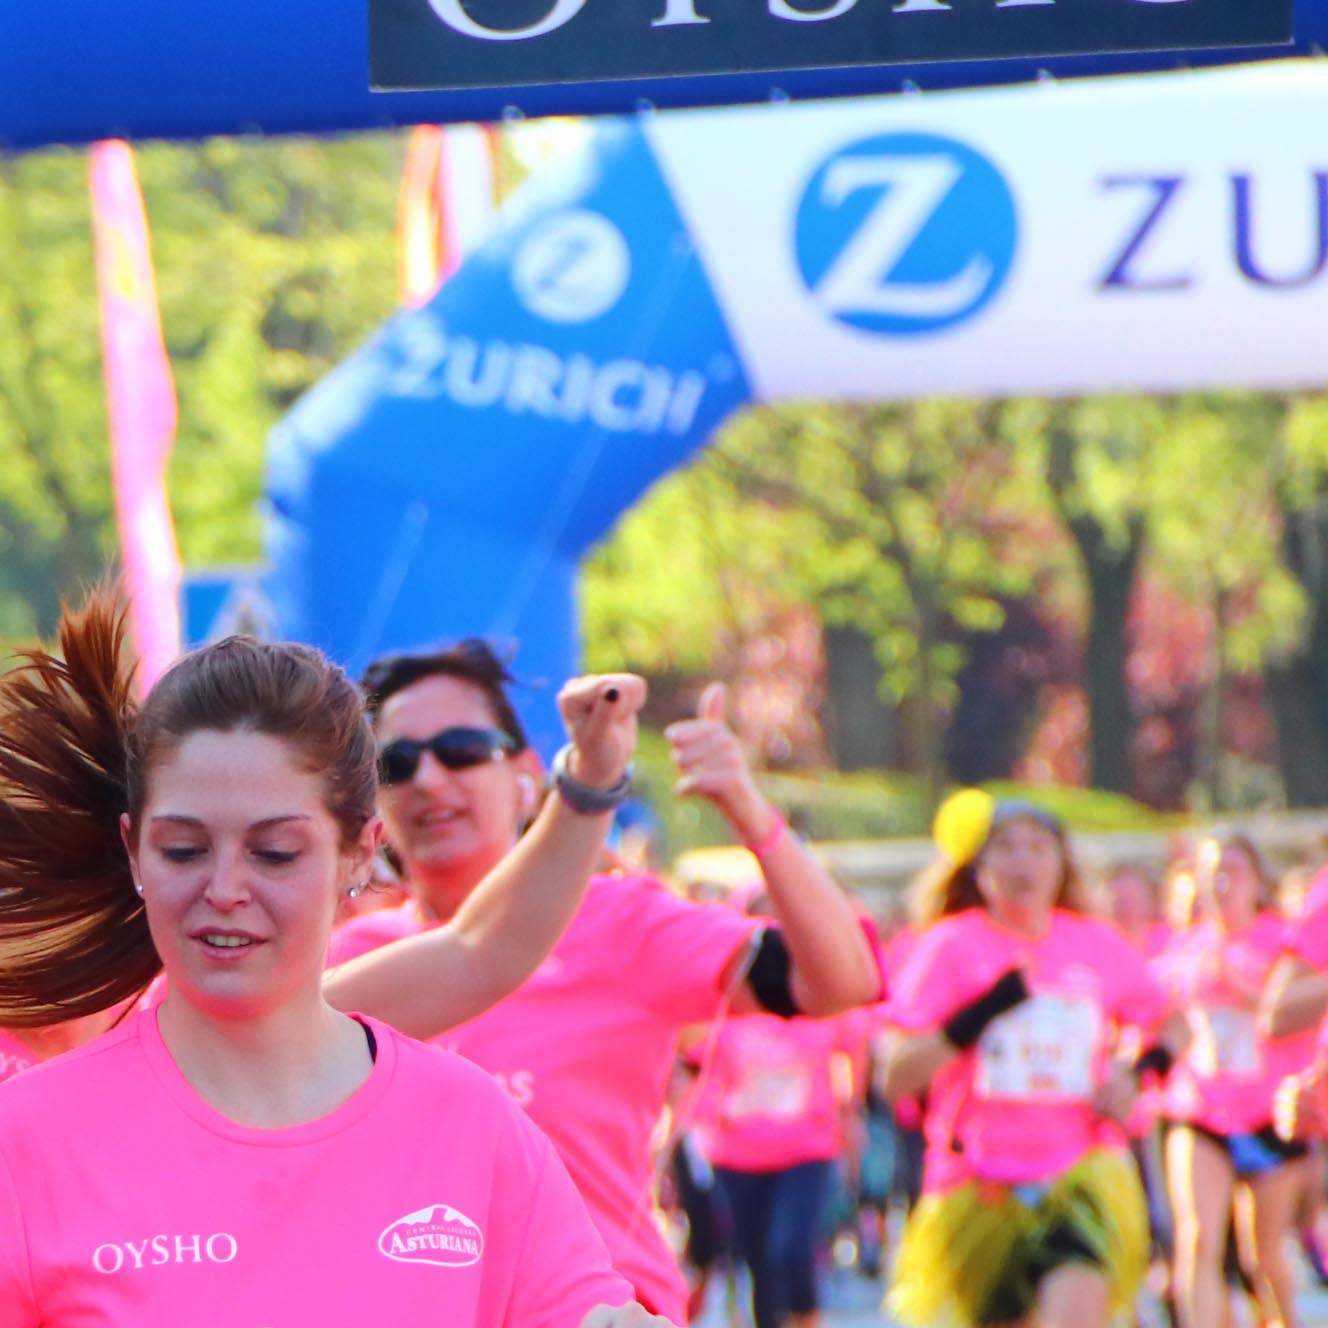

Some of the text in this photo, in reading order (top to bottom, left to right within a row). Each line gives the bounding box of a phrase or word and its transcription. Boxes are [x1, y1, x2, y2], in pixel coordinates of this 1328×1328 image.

[384, 320, 705, 436] ZURICH
[92, 1232, 238, 1274] OYSHO
[390, 1231, 479, 1257] ASTURIANA
